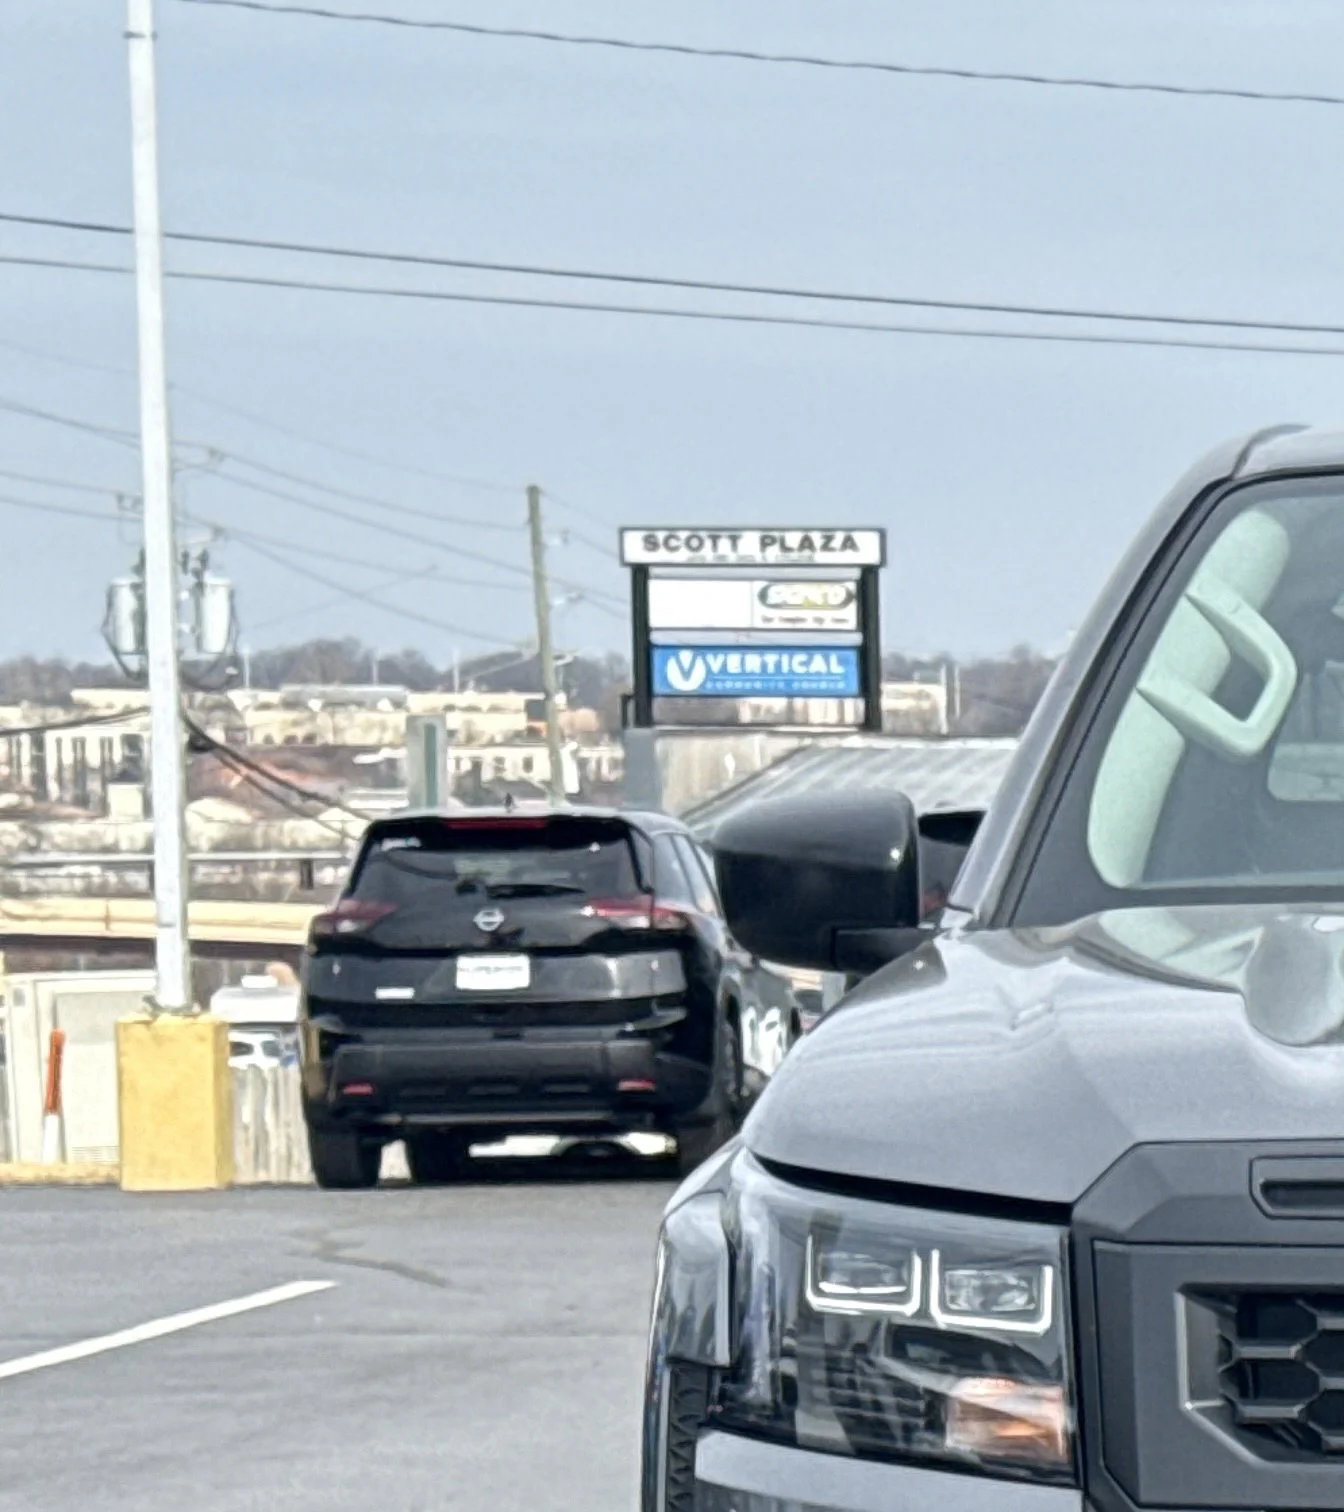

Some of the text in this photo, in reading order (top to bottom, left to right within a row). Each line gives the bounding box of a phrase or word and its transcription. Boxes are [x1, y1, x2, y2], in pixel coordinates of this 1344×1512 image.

[642, 533, 860, 553] SCOTT PLAZA
[705, 652, 845, 675] VERTICAL
